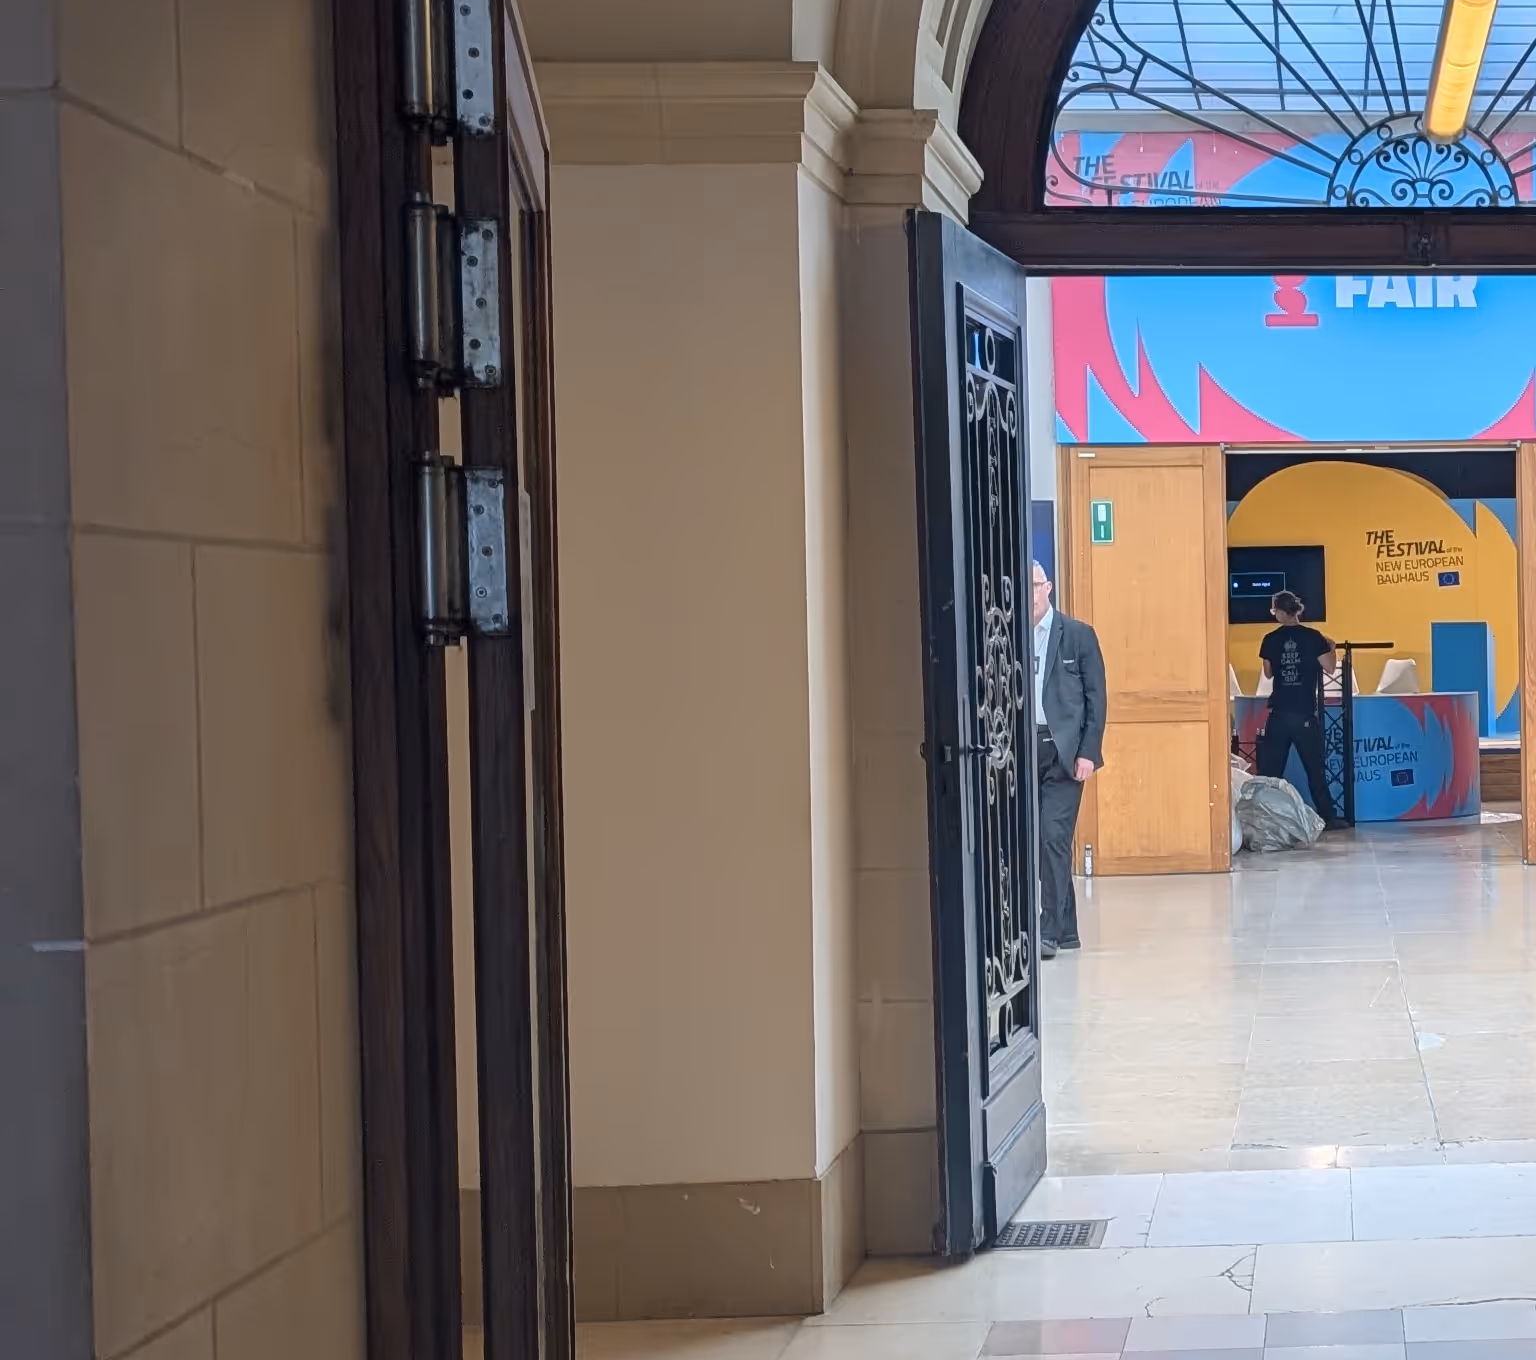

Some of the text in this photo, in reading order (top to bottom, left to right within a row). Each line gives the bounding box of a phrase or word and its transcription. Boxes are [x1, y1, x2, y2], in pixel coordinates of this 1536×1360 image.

[1073, 154, 1116, 176] THE
[1090, 170, 1194, 195] FESTIVAL
[1335, 276, 1477, 308] FAIR
[1366, 530, 1394, 545] THE
[1377, 540, 1445, 558] FESTIVAL
[1376, 556, 1464, 572] NEW EUROPEAN
[1377, 571, 1429, 585] BAUHAUS
[1354, 751, 1418, 768] EUROPEAN
